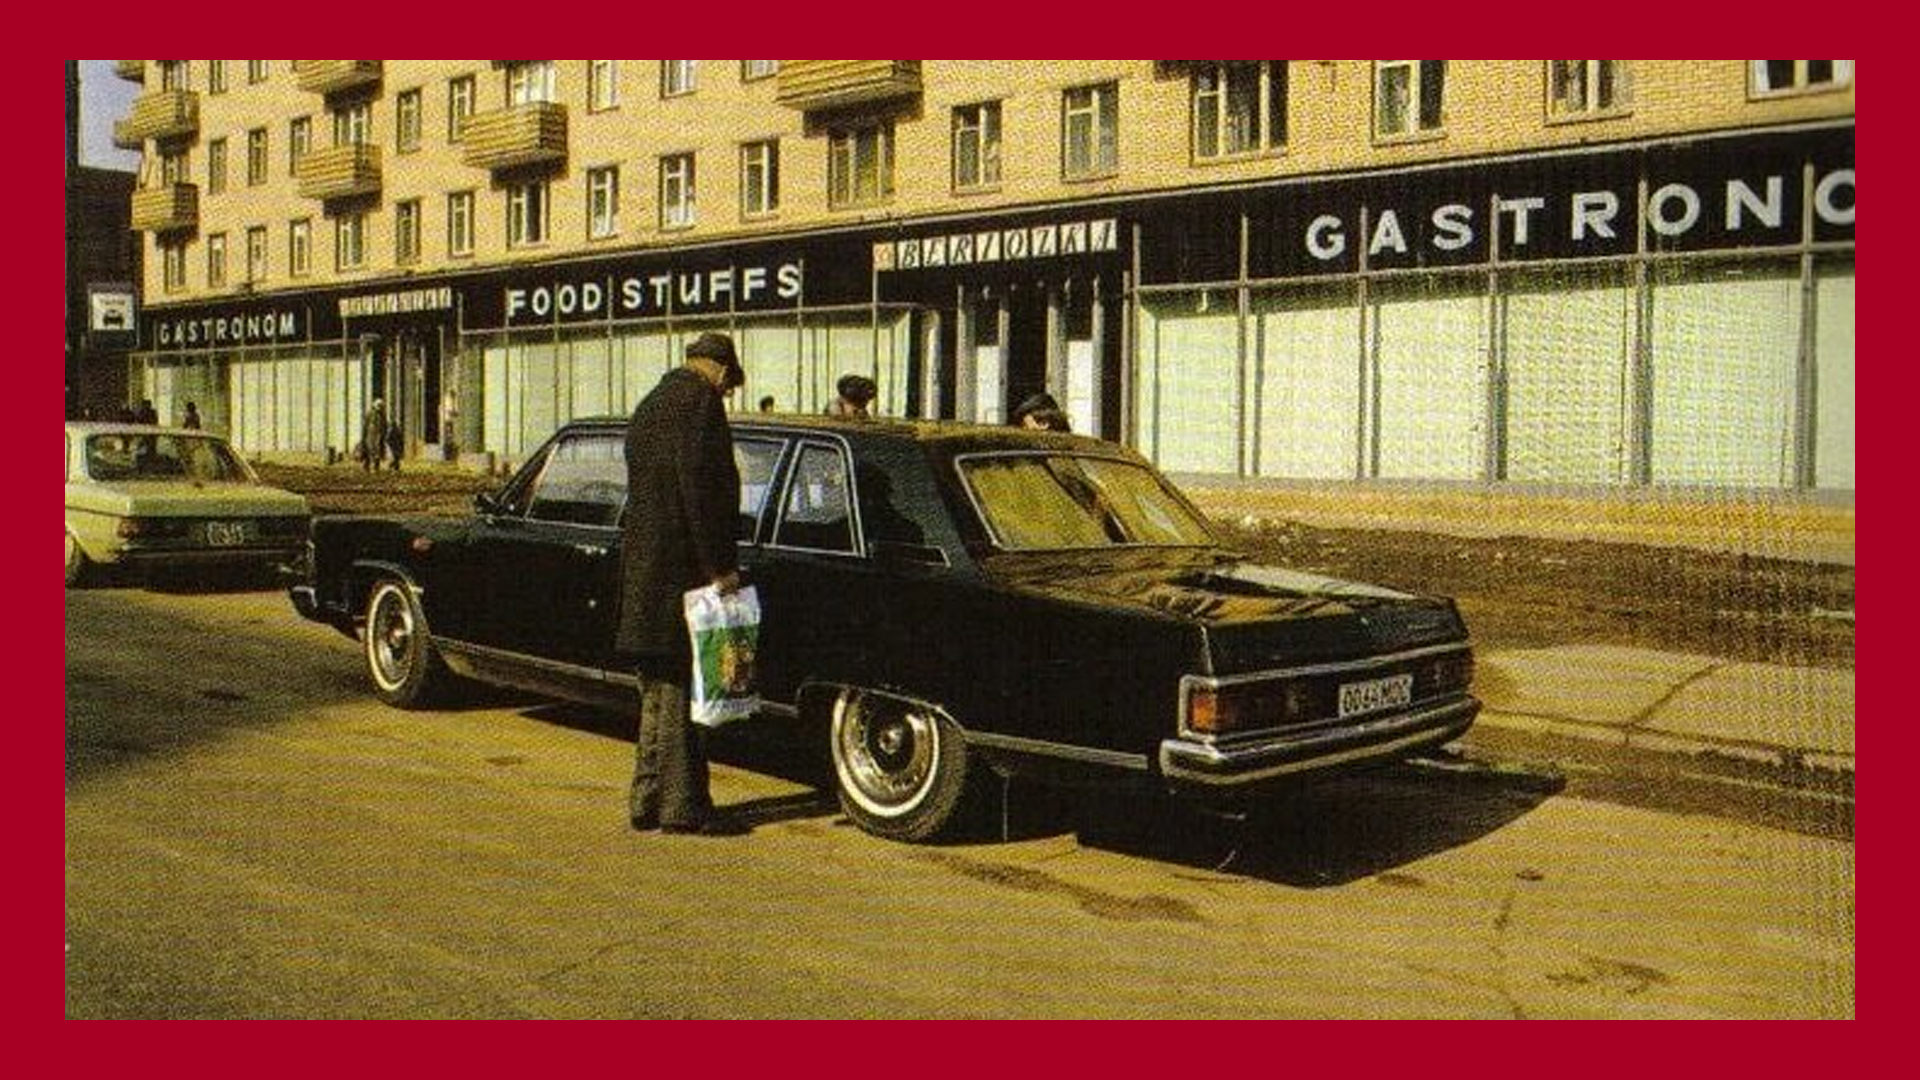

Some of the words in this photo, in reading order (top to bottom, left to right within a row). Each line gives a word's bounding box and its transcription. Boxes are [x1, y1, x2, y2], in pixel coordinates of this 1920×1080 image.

[506, 283, 601, 317] FOOD
[621, 262, 802, 309] STUFFS
[160, 312, 296, 343] GASTRONOM
